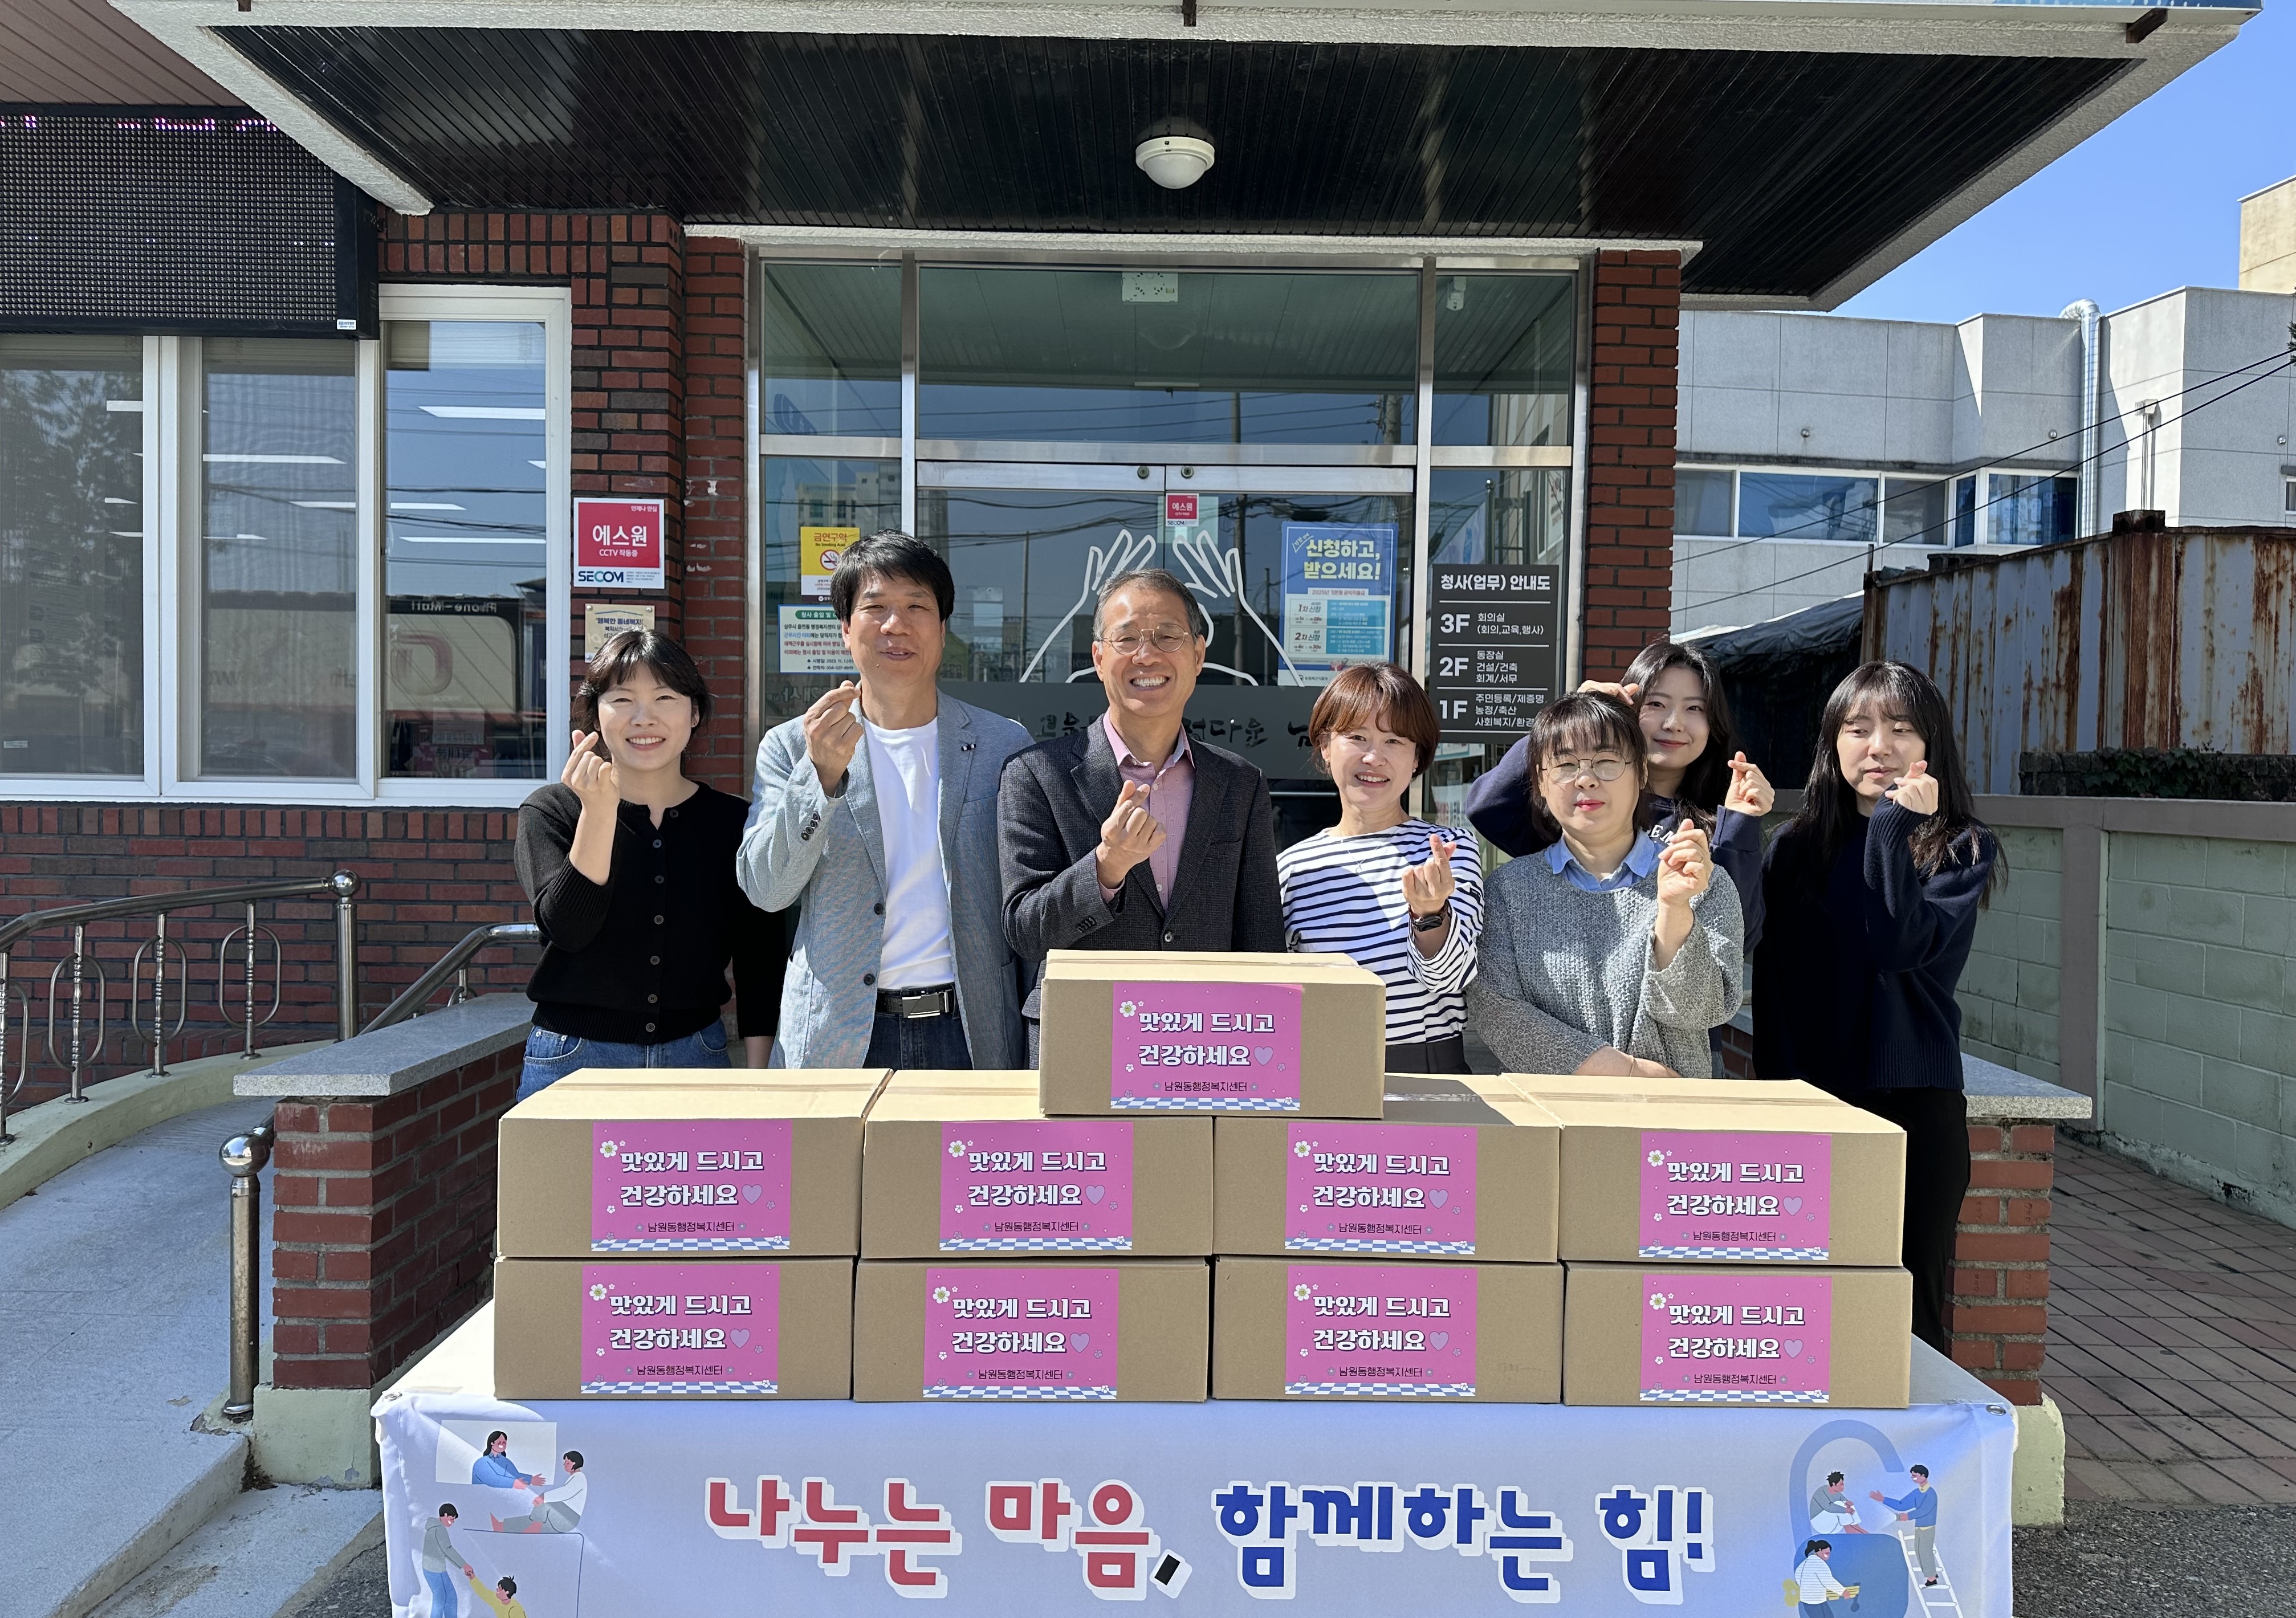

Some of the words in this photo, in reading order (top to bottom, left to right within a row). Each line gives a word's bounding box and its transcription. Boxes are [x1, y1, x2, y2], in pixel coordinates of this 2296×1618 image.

[592, 525, 647, 547] 에스원
[814, 533, 847, 541] 금연구역
[1306, 539, 1380, 560] 신청하고,
[579, 570, 624, 582] SECOM
[1304, 561, 1381, 580] 받으세요!
[1441, 574, 1506, 591] 청사(업무)
[1510, 575, 1550, 591] 안내도
[1440, 613, 1471, 633] 3F
[1477, 613, 1505, 622] 회의실
[1477, 625, 1544, 635] (회의,교육,행사)
[1477, 650, 1504, 660] 동장실
[1439, 657, 1469, 676] 2F
[1476, 663, 1517, 673] 건설/건축
[1476, 674, 1517, 683] 회계/서무
[1439, 700, 1468, 719] 1F
[1475, 706, 1517, 716] 농정/축산
[1138, 1012, 1203, 1034] 맛있게
[1210, 1013, 1276, 1034] 드시고
[1138, 1044, 1251, 1067] 건강하세요
[1164, 1081, 1248, 1093] 남원동행정복지센터
[620, 1151, 689, 1172] 맛있게
[695, 1151, 764, 1171] 드시고
[967, 1151, 1035, 1172] 맛있게
[1041, 1151, 1107, 1172] 드시고
[1312, 1152, 1378, 1173] 맛있게
[1385, 1155, 1451, 1176] 드시고
[1666, 1161, 1732, 1183] 맛있게
[1739, 1163, 1805, 1183] 드시고
[620, 1184, 739, 1207] 건강하세요
[967, 1184, 1082, 1207] 건강하세요
[1312, 1185, 1426, 1209] 건강하세요
[1666, 1195, 1780, 1216] 건강하세요
[648, 1221, 735, 1232] 남원동행정복지센터
[995, 1221, 1078, 1232] 남원동행정복지센터
[1338, 1222, 1422, 1235] 남원동행정복지센터
[1693, 1232, 1776, 1242] 남원동행정복지센터
[609, 1295, 677, 1315] 맛있게
[684, 1295, 752, 1315] 드시고
[952, 1298, 1019, 1319] 맛있게
[1025, 1298, 1092, 1319] 드시고
[1312, 1295, 1378, 1317] 맛있게
[1385, 1297, 1451, 1318] 드시고
[1667, 1305, 1733, 1326] 맛있게
[1740, 1306, 1806, 1326] 드시고
[609, 1328, 727, 1350] 건강하세요
[951, 1331, 1067, 1354] 건강하세요
[1312, 1329, 1426, 1352] 건강하세요
[1667, 1337, 1781, 1359] 건강하세요
[637, 1365, 723, 1376] 남원동행정복지센터
[978, 1369, 1062, 1380] 남원동행정복지센터
[1339, 1366, 1423, 1377] 남원동행정복지센터
[1694, 1374, 1777, 1384] 남원동행정복지센터
[705, 1475, 962, 1598] 나누는
[1211, 1481, 1573, 1604] 함께하는
[1596, 1485, 1716, 1605] 힘!
